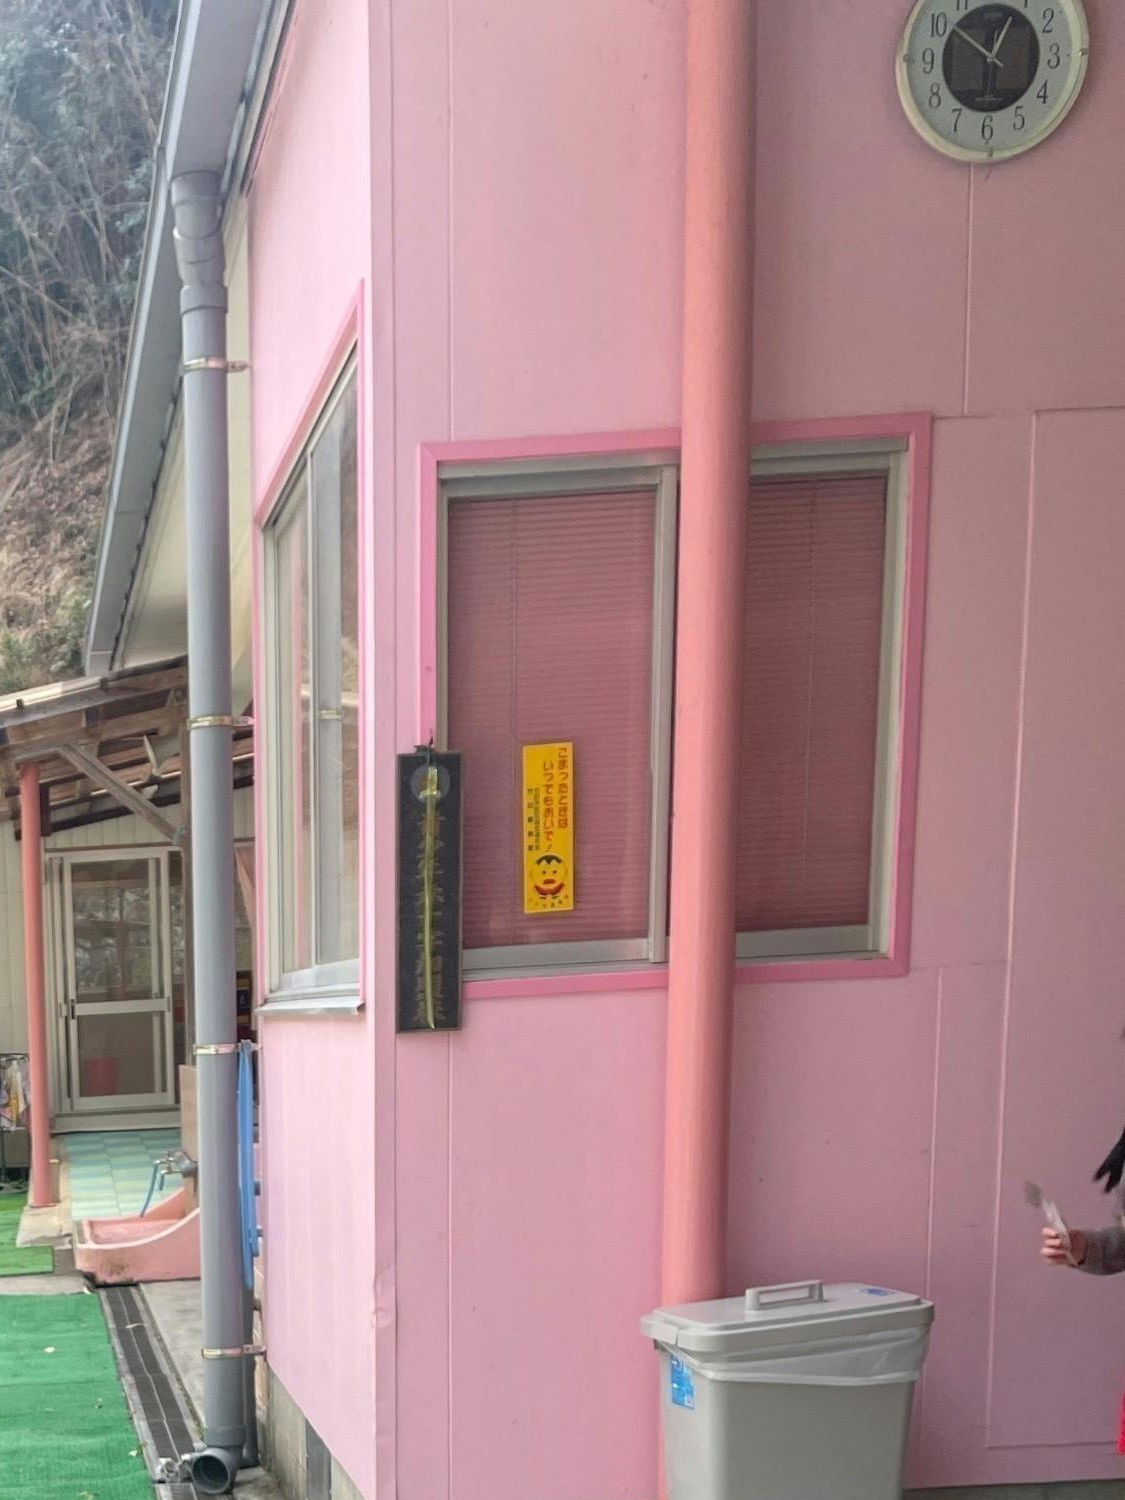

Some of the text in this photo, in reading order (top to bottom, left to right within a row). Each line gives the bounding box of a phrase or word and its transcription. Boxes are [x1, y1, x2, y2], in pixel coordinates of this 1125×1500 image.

[930, 12, 947, 37] 10
[1042, 8, 1055, 33] 2
[922, 48, 935, 74] 9
[1047, 43, 1061, 69] 3
[928, 82, 942, 108] 8
[1036, 79, 1049, 104] 4
[951, 108, 962, 132] 7
[981, 115, 994, 141] 6
[1012, 106, 1025, 130] 5
[558, 747, 569, 829] こまったときは
